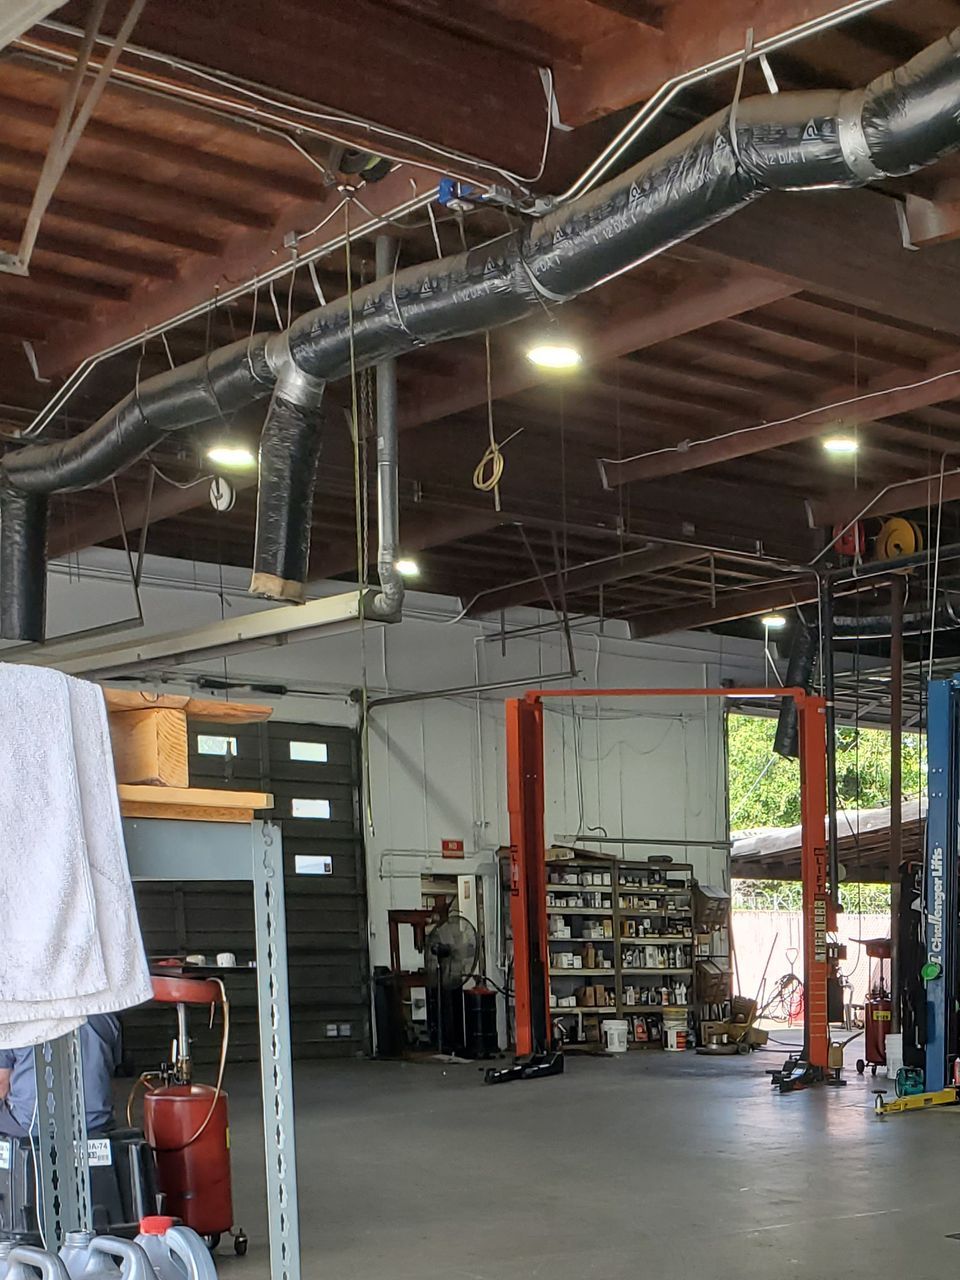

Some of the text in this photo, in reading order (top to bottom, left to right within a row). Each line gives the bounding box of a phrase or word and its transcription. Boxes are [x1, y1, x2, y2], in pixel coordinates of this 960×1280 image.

[816, 857, 824, 892] LIFT
[931, 847, 943, 877] Lifts
[928, 877, 945, 952] Challenger
